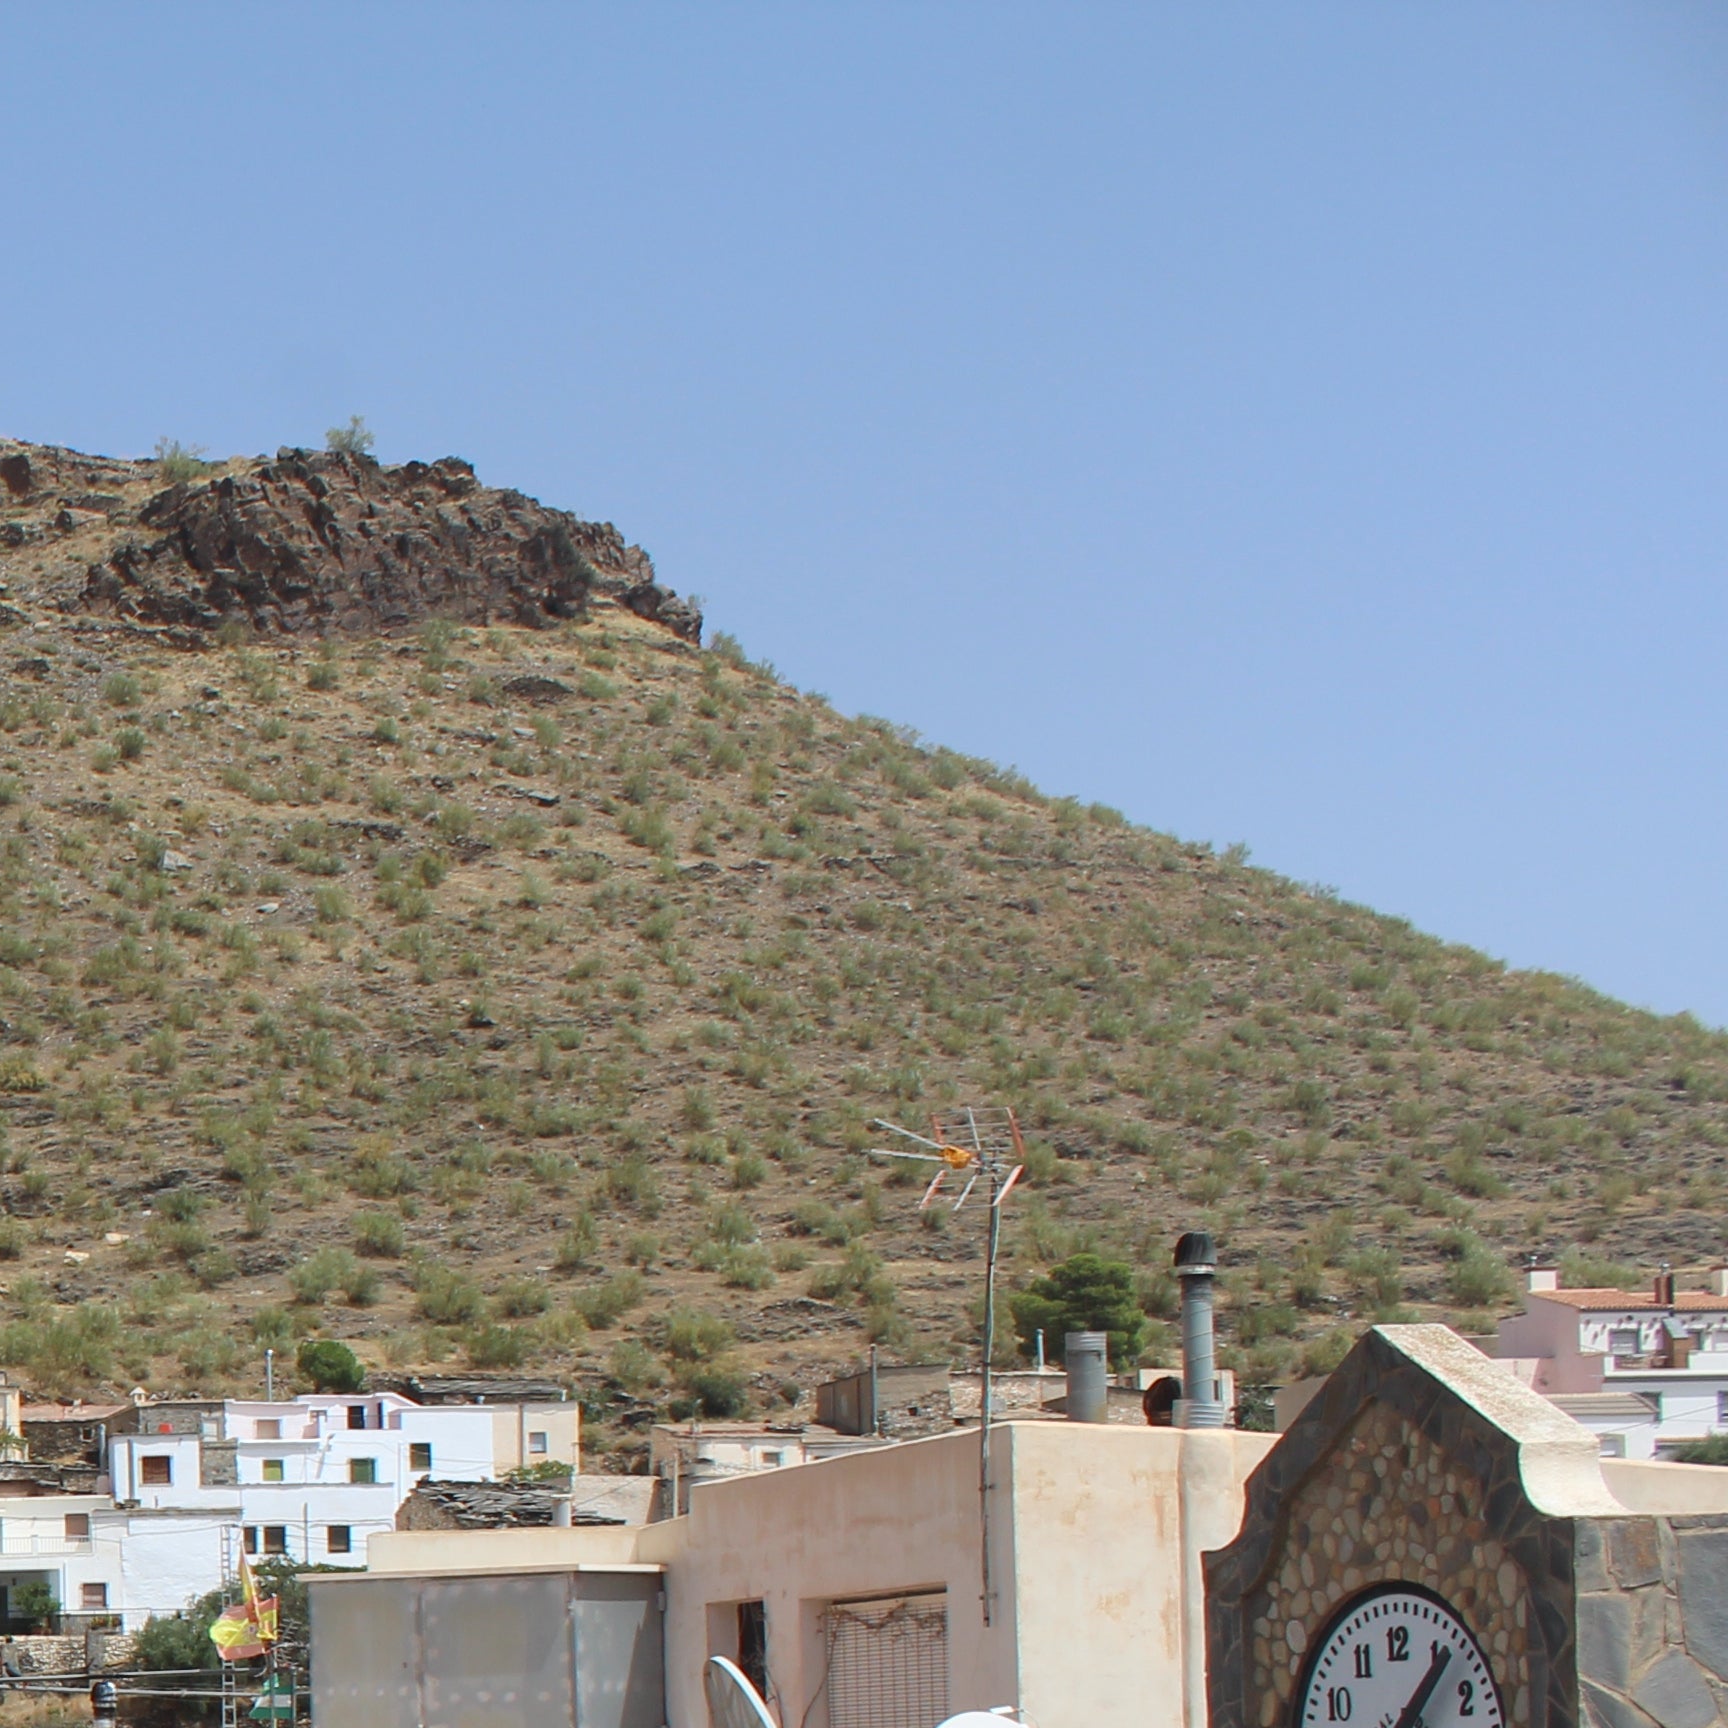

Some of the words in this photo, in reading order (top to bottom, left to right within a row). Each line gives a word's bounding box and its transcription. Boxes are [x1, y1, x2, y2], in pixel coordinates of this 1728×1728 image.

[1354, 1643, 1372, 1678] 11
[1387, 1626, 1409, 1661] 12
[1327, 1686, 1351, 1722] 10
[1457, 1680, 1473, 1716] 2
